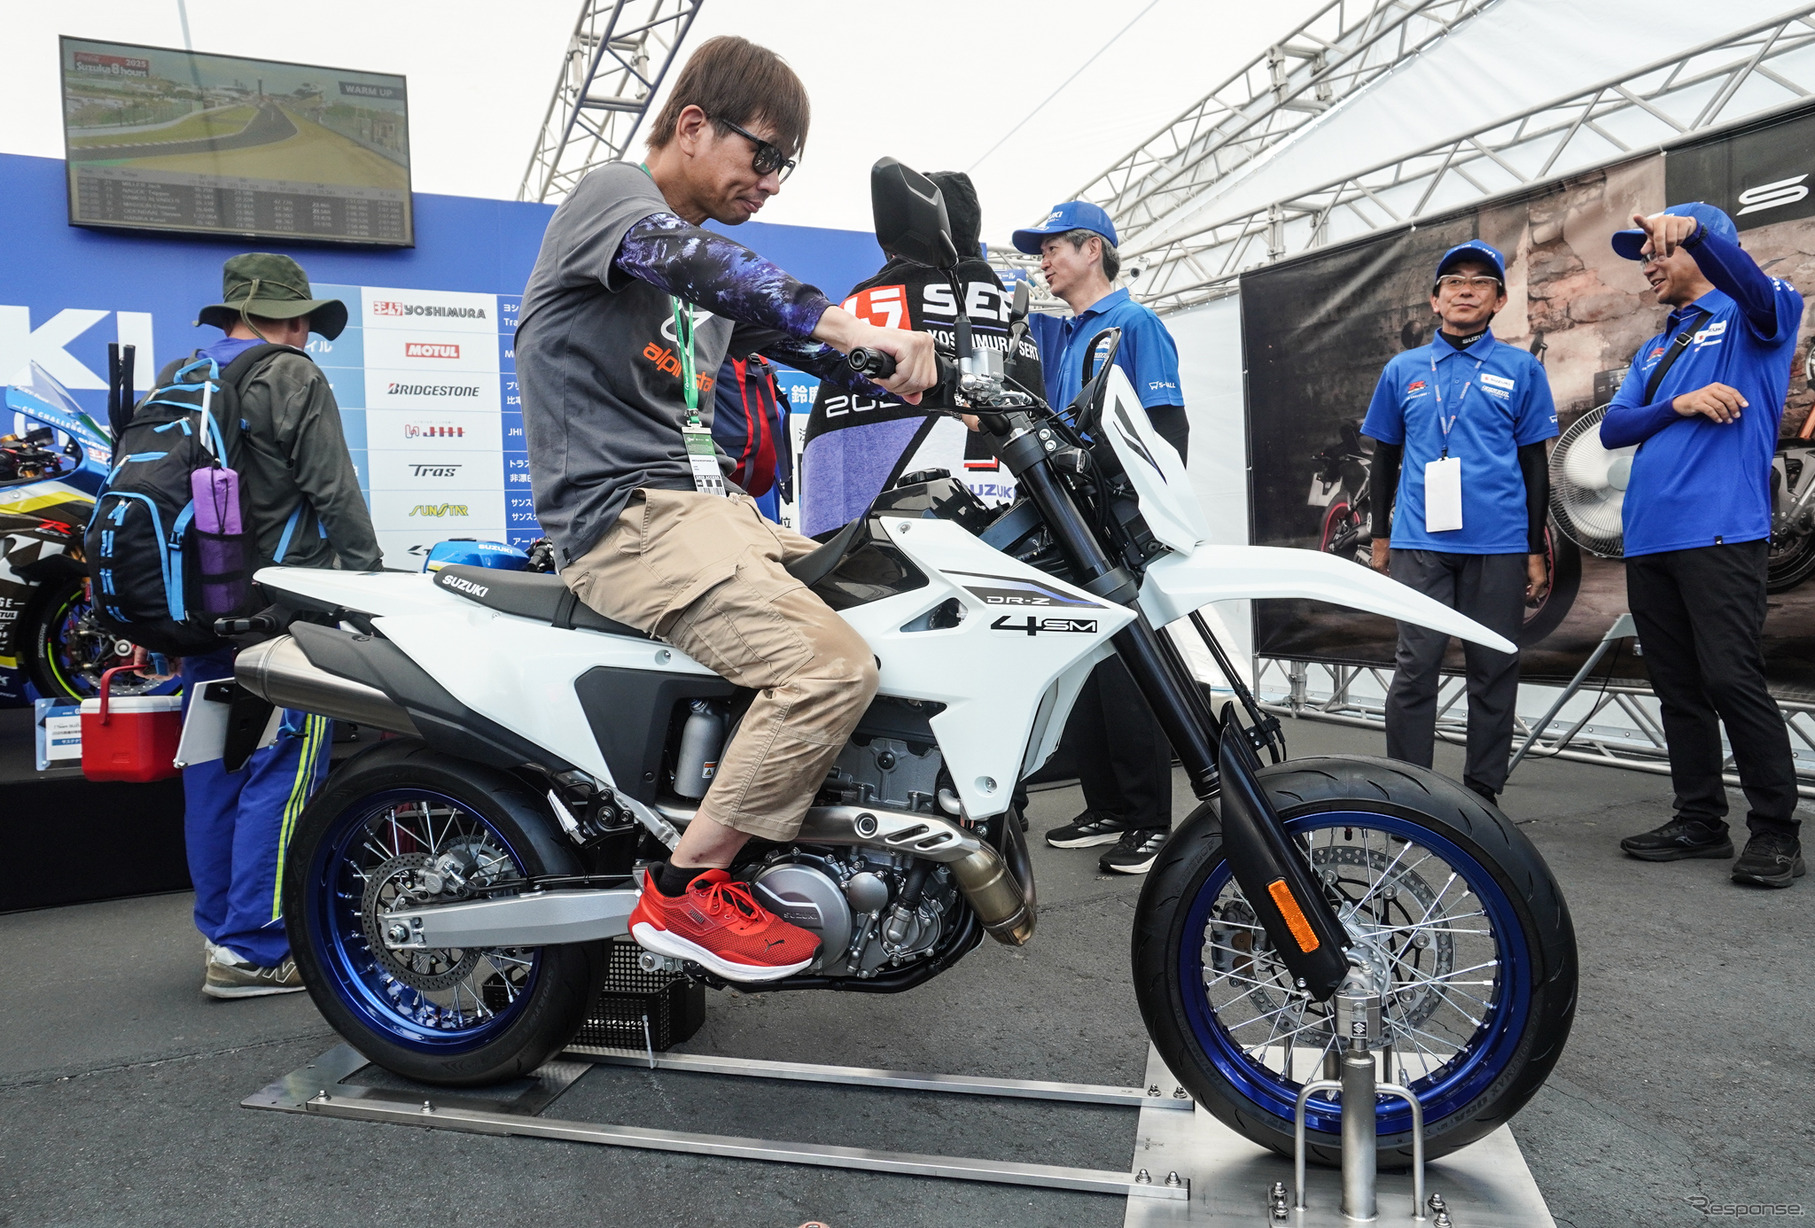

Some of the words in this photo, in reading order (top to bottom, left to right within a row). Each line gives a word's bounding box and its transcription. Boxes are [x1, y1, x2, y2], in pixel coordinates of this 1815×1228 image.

[76, 62, 111, 74] Suzuka
[111, 63, 120, 74] 8
[120, 67, 148, 77] hours
[345, 84, 377, 96] WARM
[379, 88, 393, 97] UP
[374, 301, 403, 316] ヨシムラ
[404, 304, 487, 319] YOSHIMURA
[408, 345, 458, 358] MOTUL
[926, 329, 1013, 353] YOSIMURA
[1019, 340, 1040, 361] SERT
[388, 383, 480, 397] BRIDGESTONE
[508, 427, 523, 436] JHI
[408, 464, 462, 477] Tras
[409, 503, 469, 517] SUNSTAR
[478, 543, 513, 554] SUZUKI
[442, 574, 489, 598] SUZUKI
[986, 596, 1050, 605] DR-Z
[688, 908, 705, 924] PUMA
